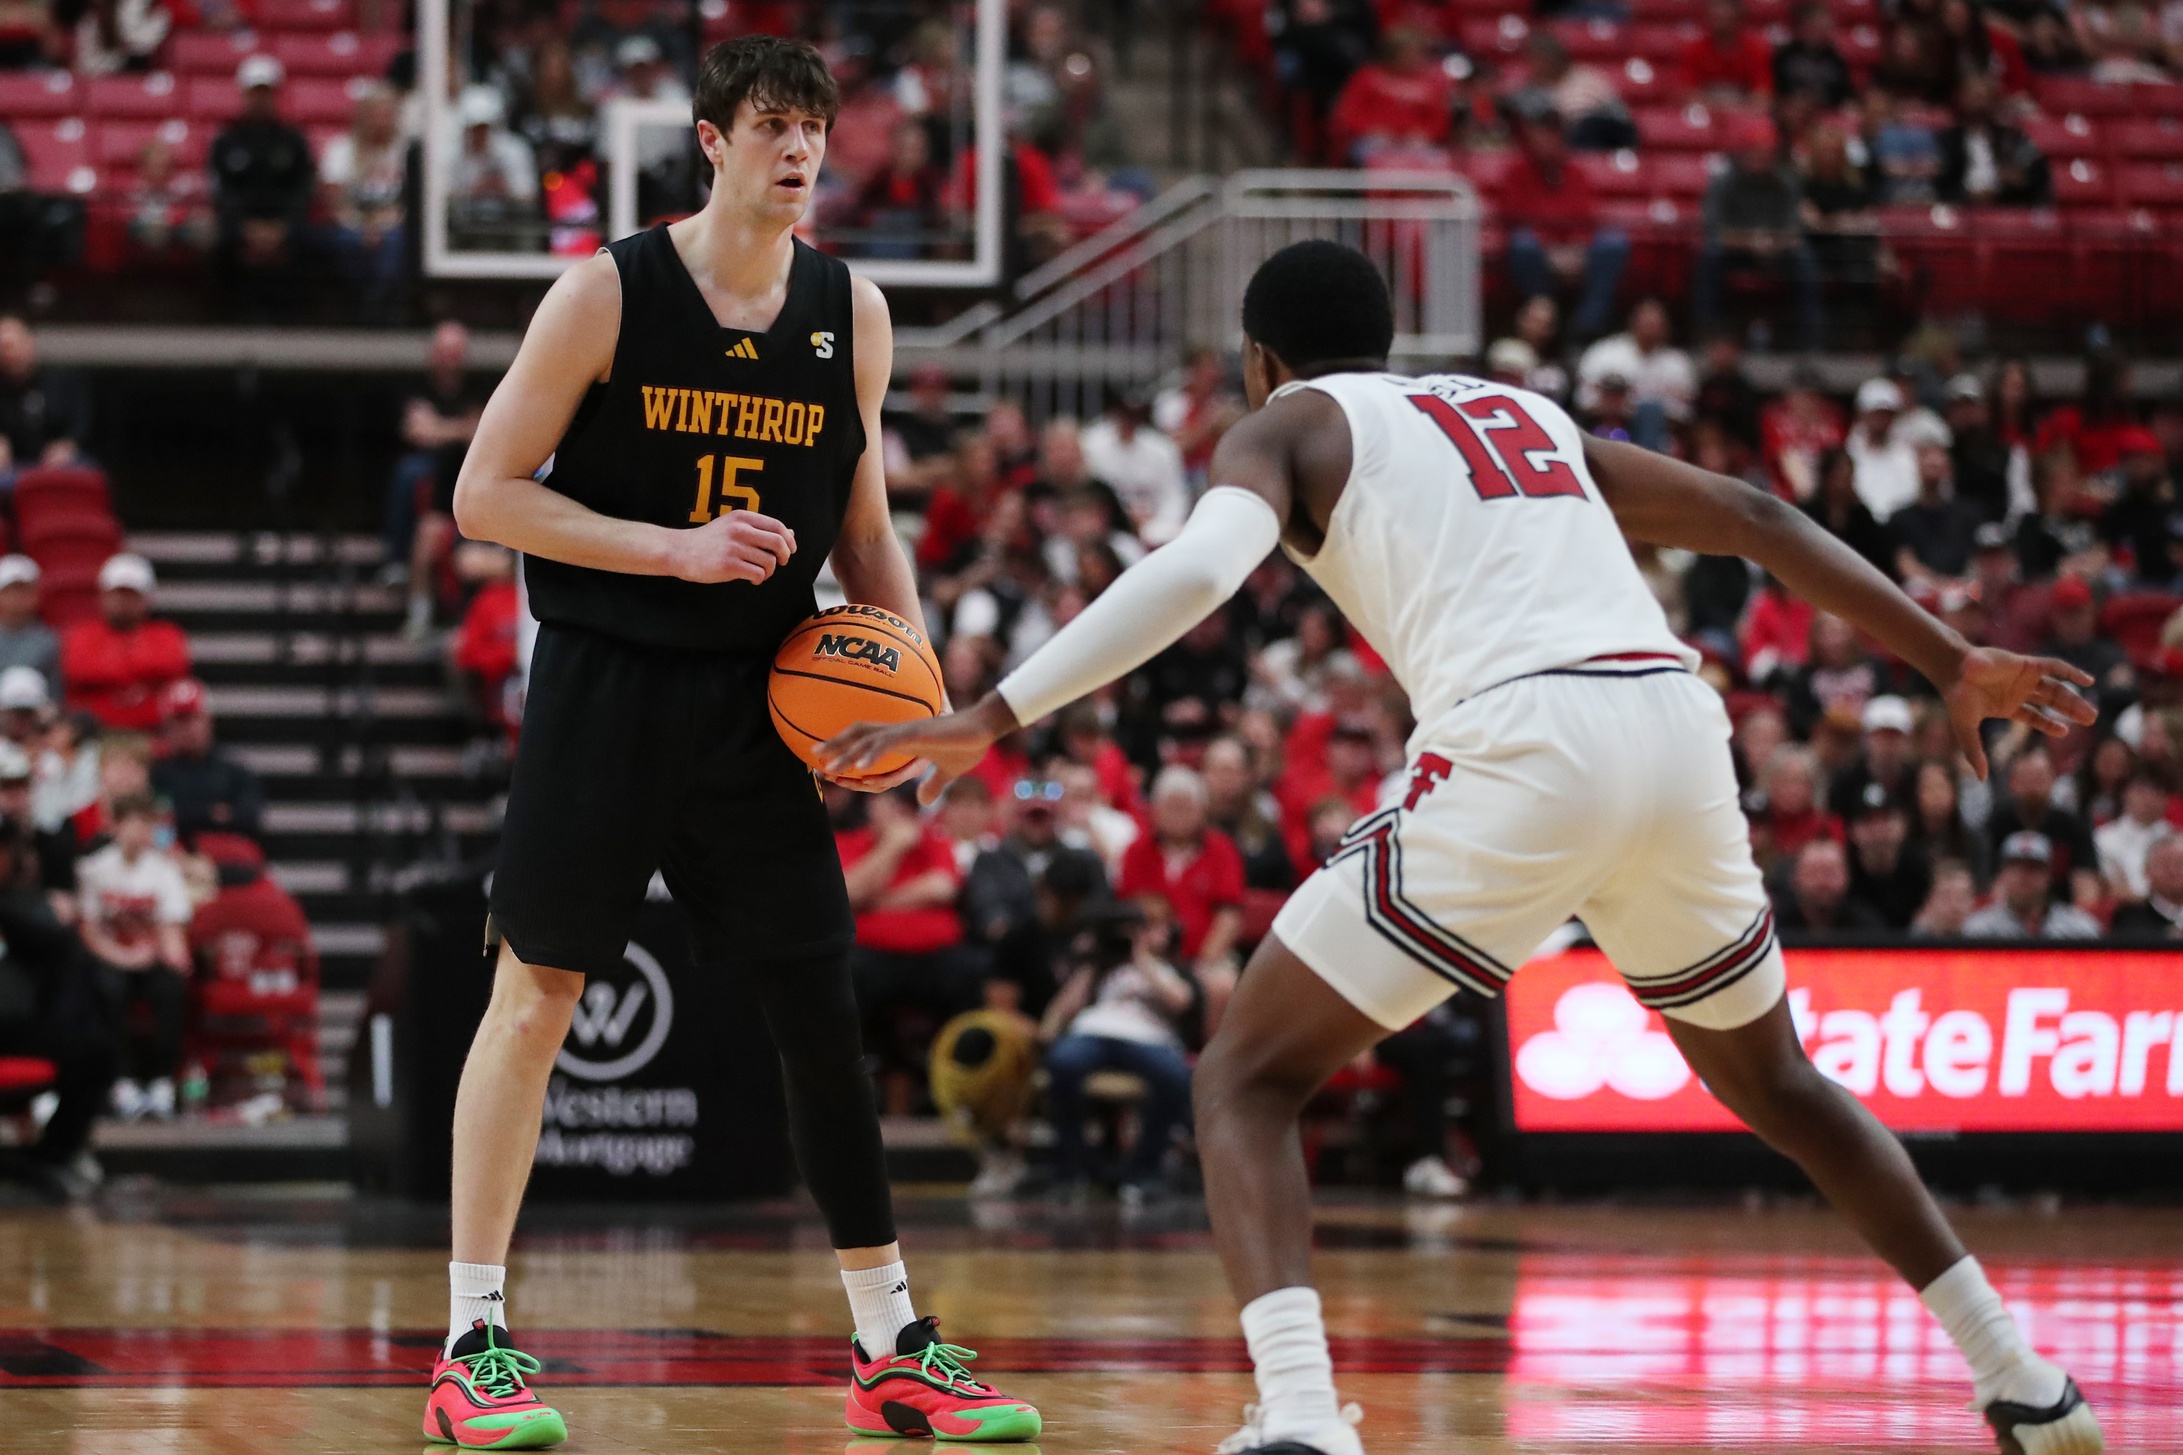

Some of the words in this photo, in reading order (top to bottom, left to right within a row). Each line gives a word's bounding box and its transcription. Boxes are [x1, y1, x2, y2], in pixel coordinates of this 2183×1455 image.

[641, 384, 825, 448] WINTHROP
[1403, 393, 1591, 503] 12
[688, 453, 765, 524] 15
[811, 656, 846, 665] OFFICIAL
[847, 660, 872, 670] GAME
[813, 632, 902, 674] NCAA
[1788, 986, 1993, 1099] ate
[1998, 986, 2183, 1099] Far
